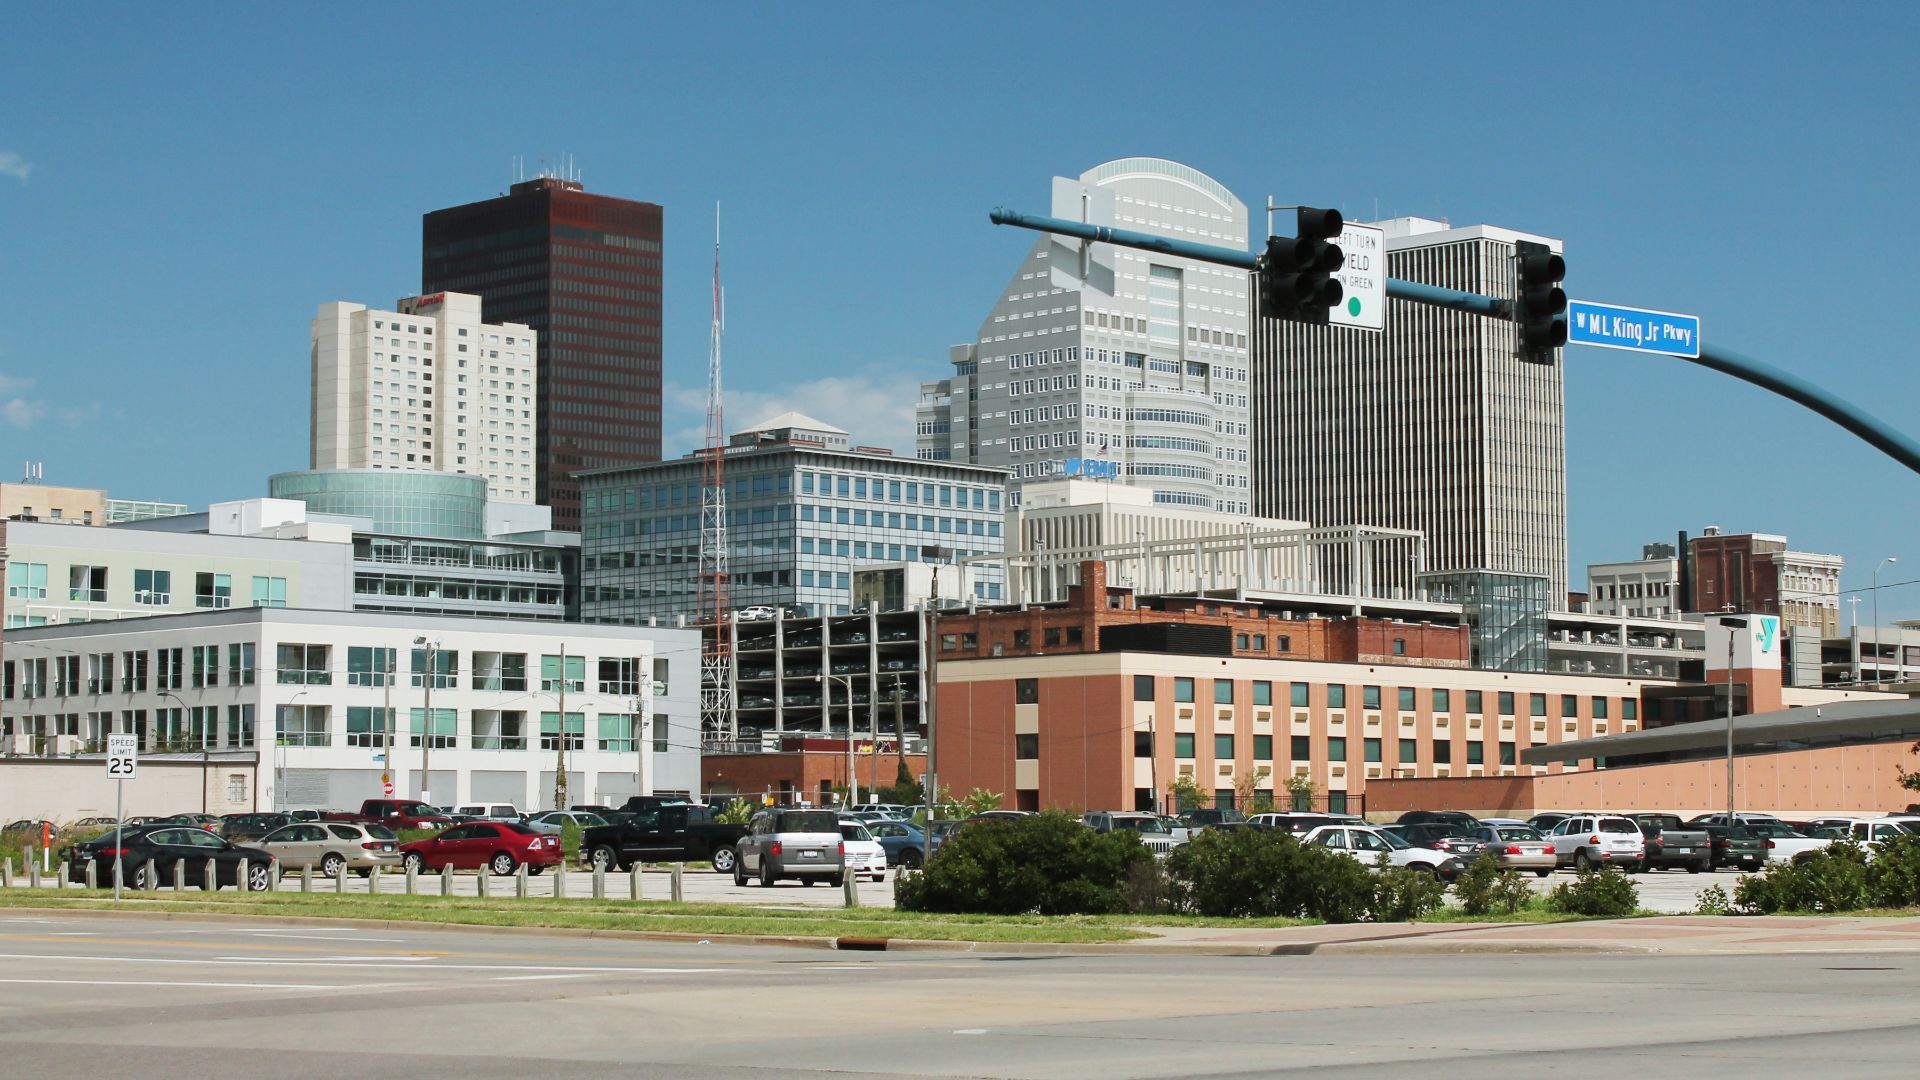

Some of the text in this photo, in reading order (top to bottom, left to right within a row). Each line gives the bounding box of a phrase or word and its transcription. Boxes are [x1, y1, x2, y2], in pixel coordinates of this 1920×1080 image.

[1356, 234, 1376, 250] TURN
[1350, 276, 1373, 289] GREEN
[1576, 312, 1586, 328] W
[1613, 316, 1642, 346] King
[1645, 321, 1660, 342] Jr
[1663, 323, 1691, 347] Pkwy
[110, 739, 135, 747] SPEED
[112, 748, 132, 756] LIMIT
[109, 758, 134, 774] 25
